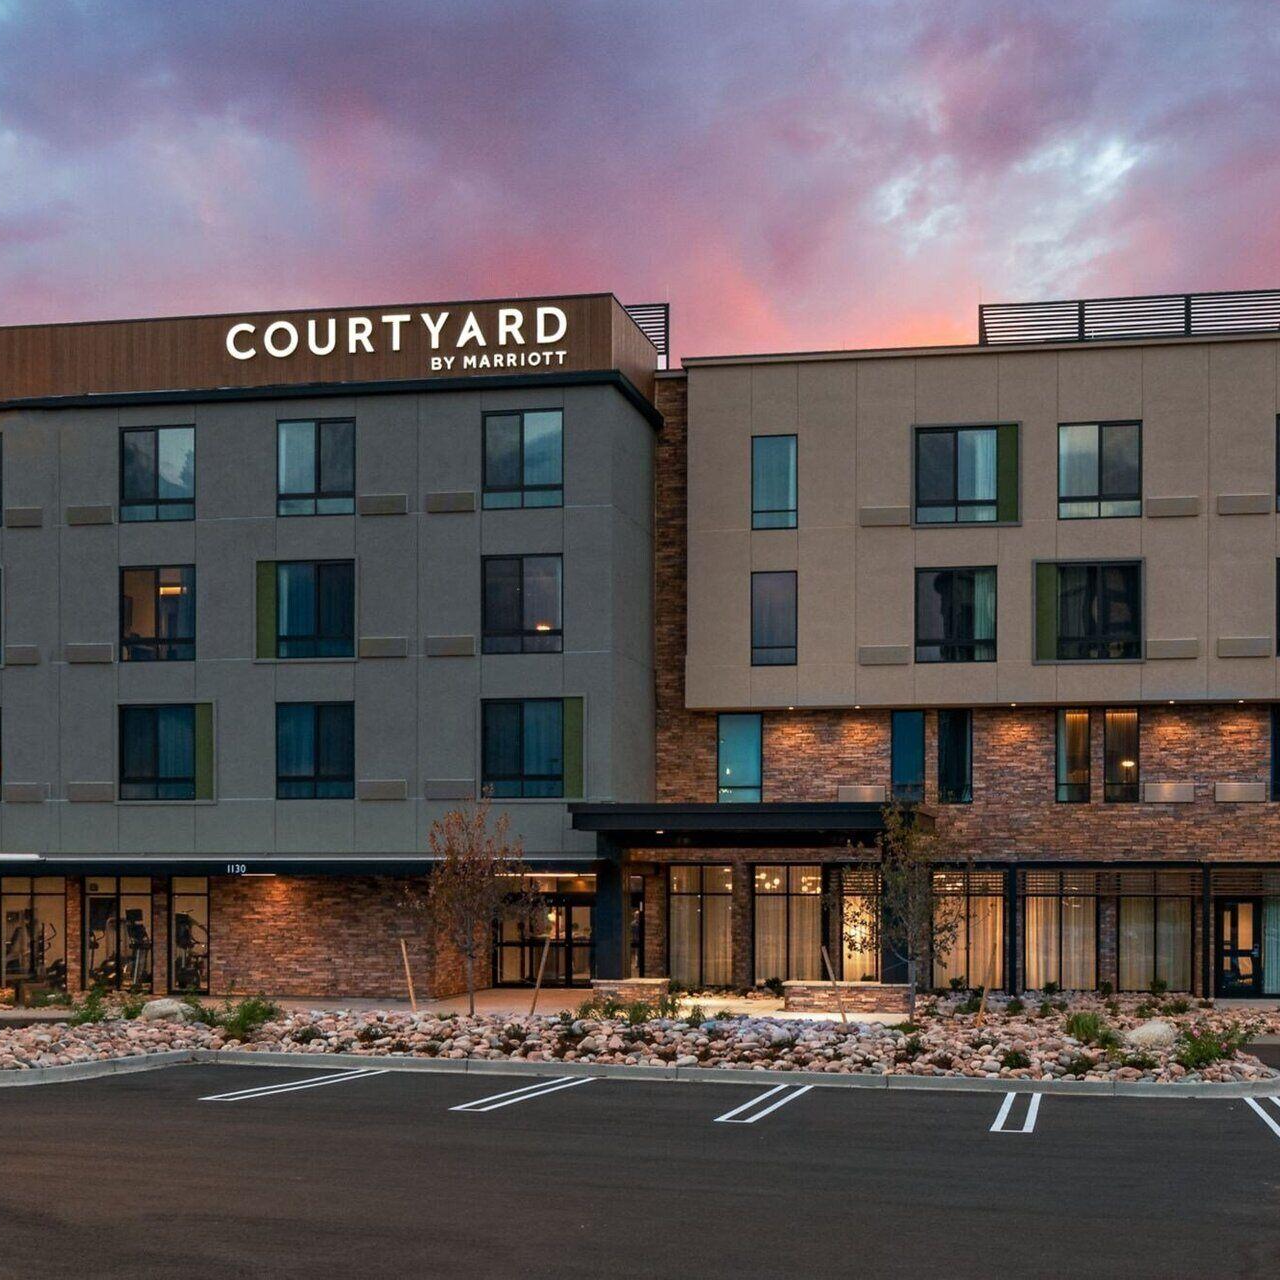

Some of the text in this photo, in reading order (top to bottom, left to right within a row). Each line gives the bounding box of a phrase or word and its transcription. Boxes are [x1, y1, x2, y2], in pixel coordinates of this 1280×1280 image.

[225, 307, 568, 360] COURTYARD
[430, 350, 568, 371] BY MARRIOTT
[227, 864, 247, 873] 1130
